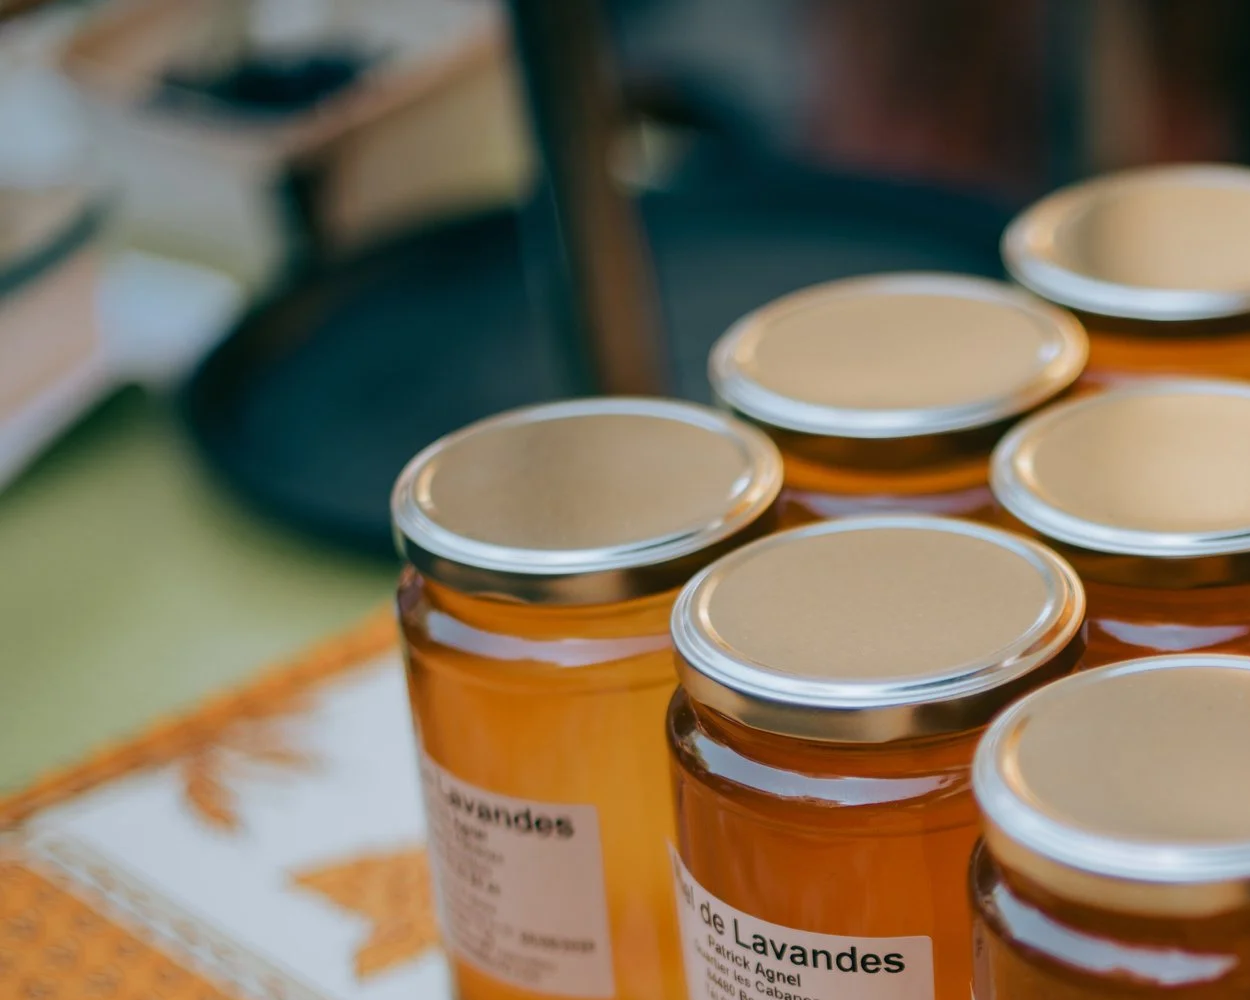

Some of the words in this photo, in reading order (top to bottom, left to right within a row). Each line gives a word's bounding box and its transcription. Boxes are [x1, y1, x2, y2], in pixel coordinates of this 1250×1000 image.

[699, 900, 725, 936] de
[733, 917, 906, 974] Lavandes
[708, 933, 751, 971] Patrick
[755, 960, 802, 988] Agnel
[733, 969, 752, 989] les
